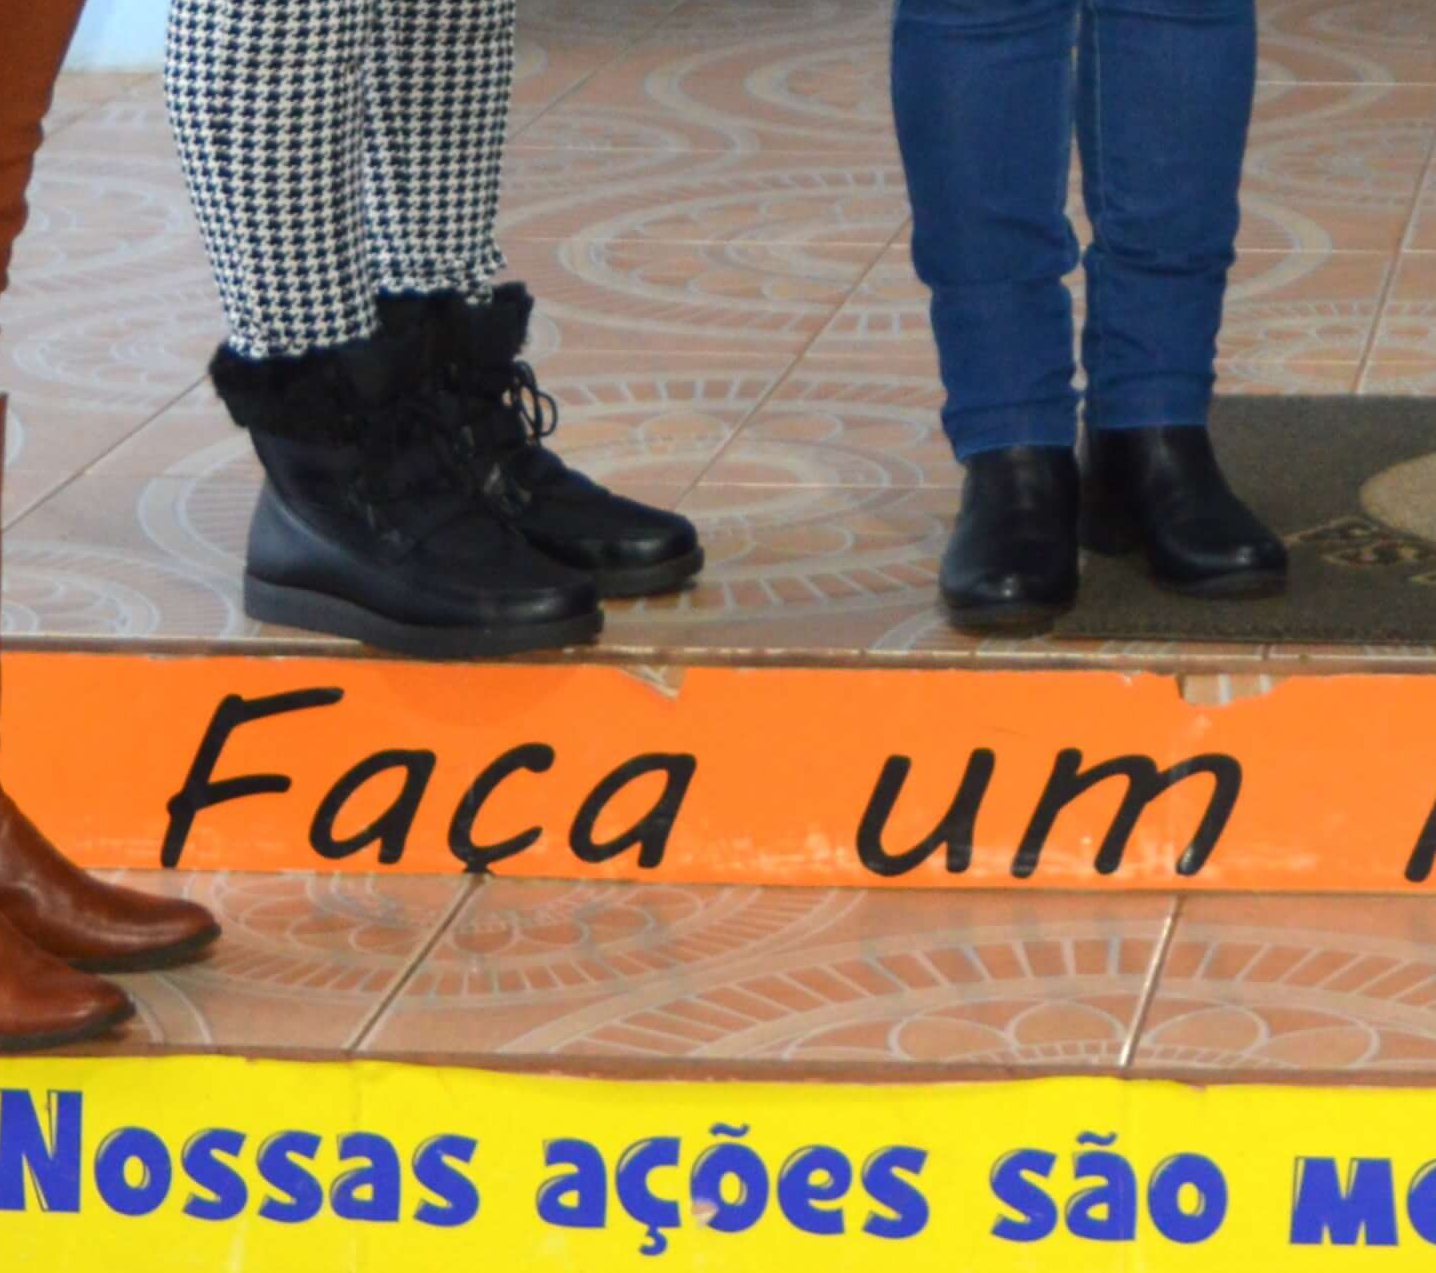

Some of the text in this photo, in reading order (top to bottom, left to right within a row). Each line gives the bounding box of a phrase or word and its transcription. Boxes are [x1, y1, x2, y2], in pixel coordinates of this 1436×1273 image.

[158, 686, 698, 876] Faça
[855, 747, 1243, 879] um
[536, 1122, 931, 1256] ações
[988, 1131, 1228, 1245] são
